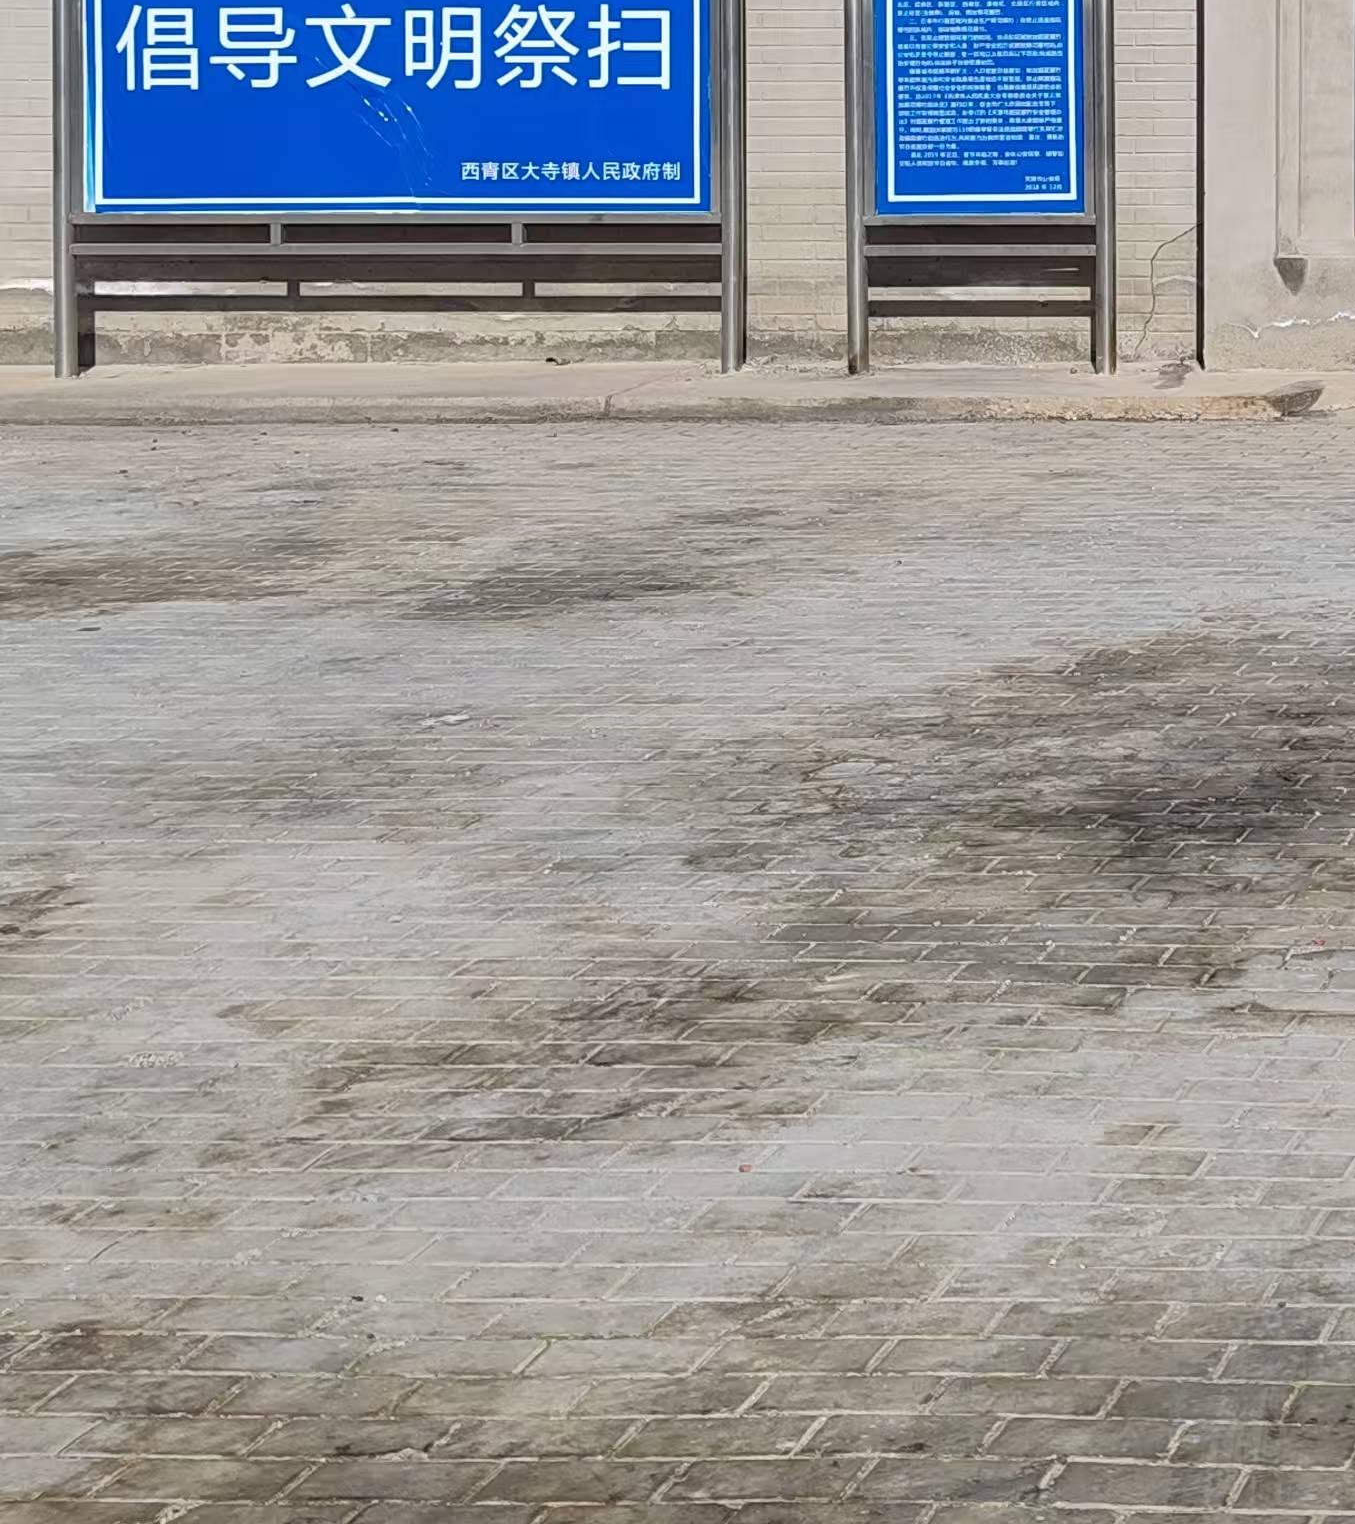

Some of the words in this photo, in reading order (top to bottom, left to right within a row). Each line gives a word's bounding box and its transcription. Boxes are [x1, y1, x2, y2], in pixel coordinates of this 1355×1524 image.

[115, 3, 671, 90] 倡导文明祭扫
[461, 161, 681, 181] 西青区大寺镇人民政府制
